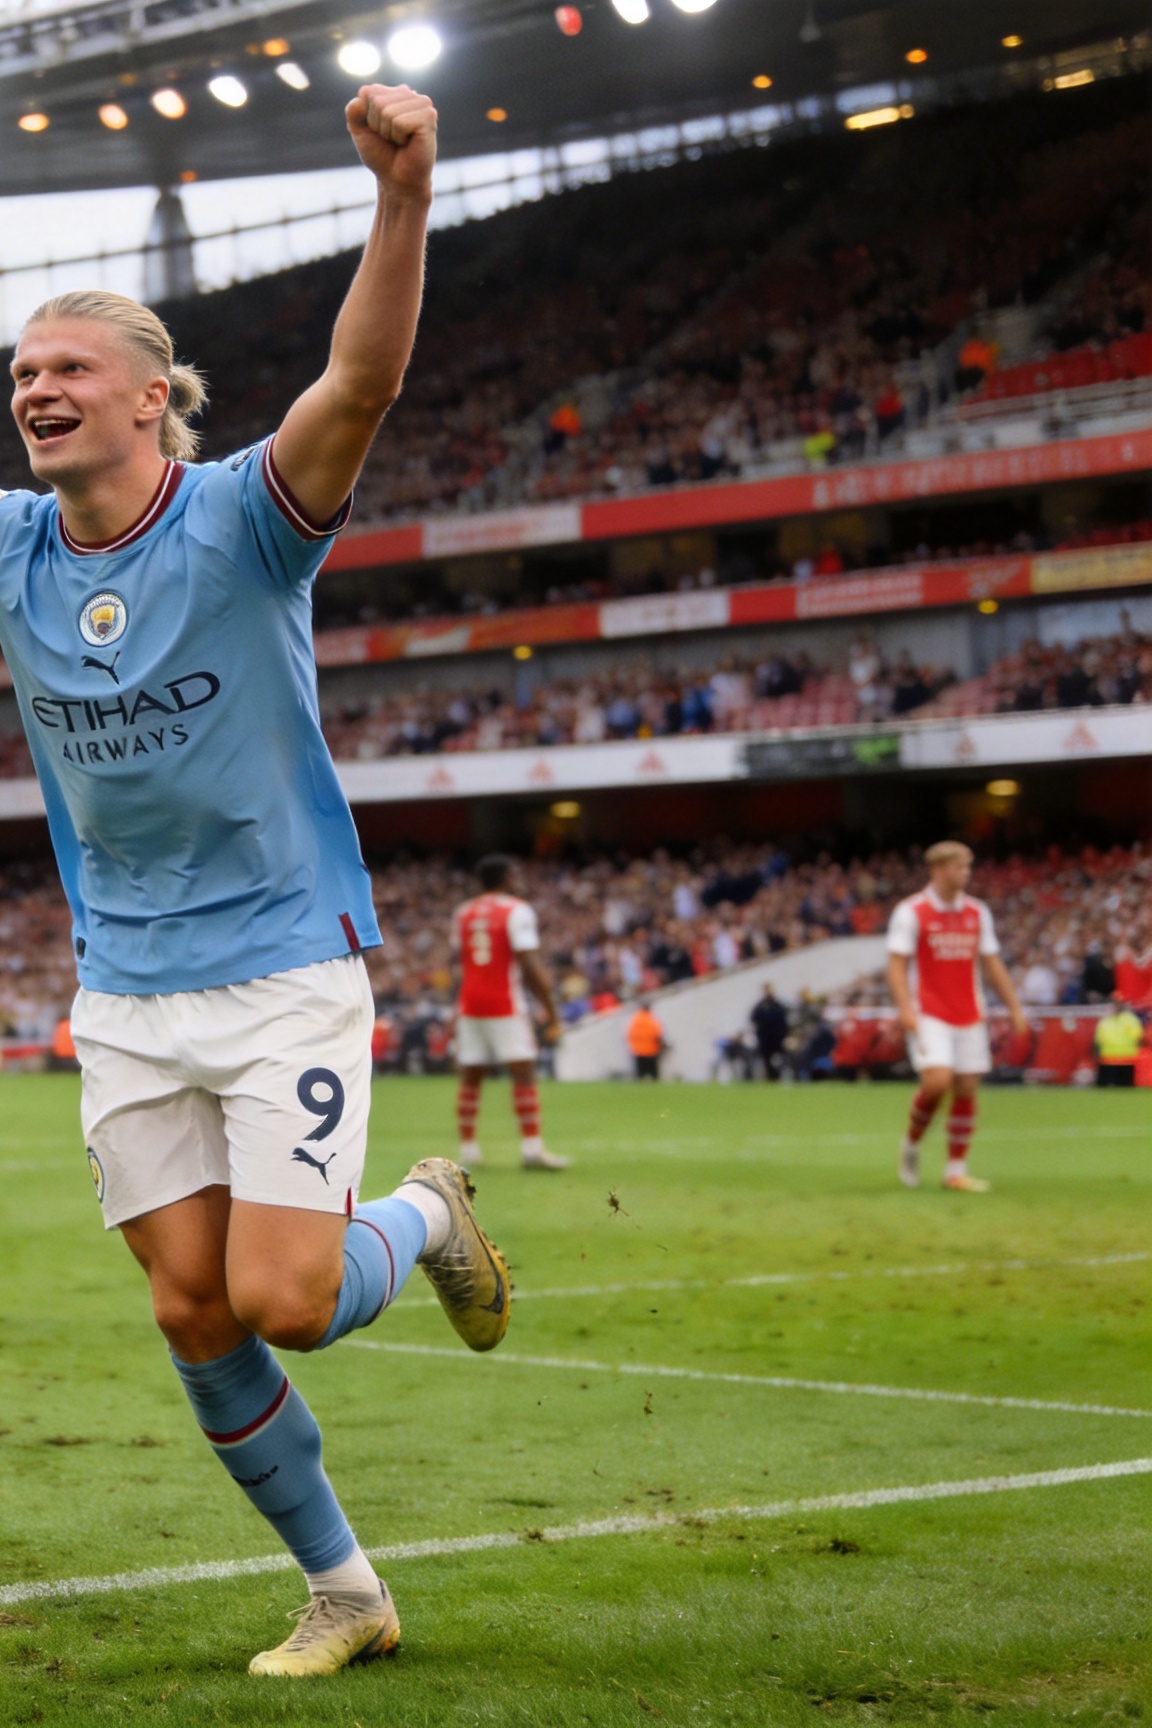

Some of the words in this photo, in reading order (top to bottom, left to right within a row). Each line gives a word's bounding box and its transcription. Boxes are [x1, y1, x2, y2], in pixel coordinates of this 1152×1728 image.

[32, 671, 220, 732] ETIHAD
[63, 724, 189, 765] AIRWAYS
[297, 1067, 345, 1142] 9
